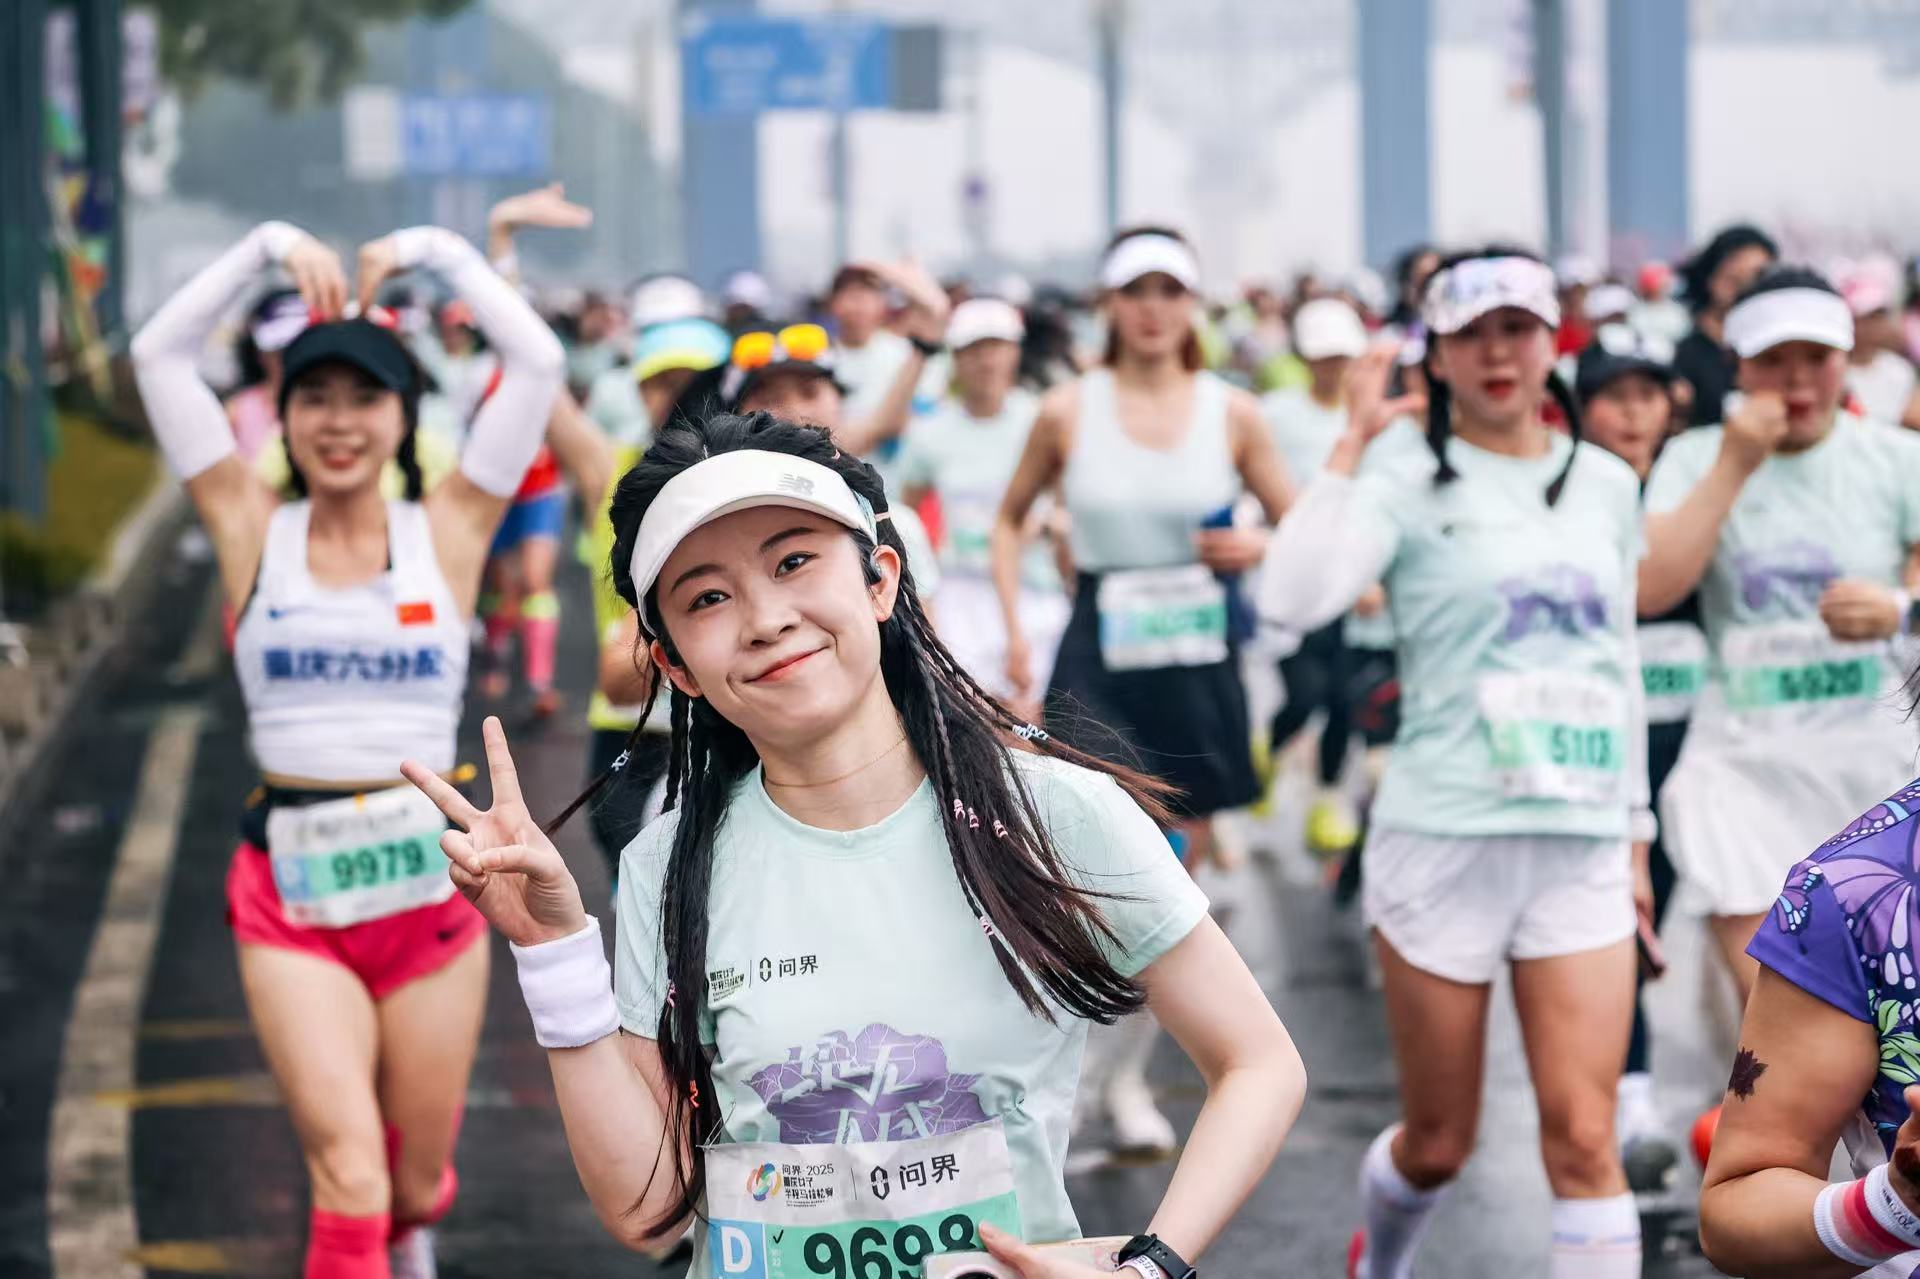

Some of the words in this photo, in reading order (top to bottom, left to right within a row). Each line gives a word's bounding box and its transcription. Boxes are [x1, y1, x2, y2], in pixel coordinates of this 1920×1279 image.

[331, 838, 426, 890] 9979
[779, 955, 818, 978] 问界
[899, 1153, 960, 1191] 问界
[721, 1226, 753, 1273] D
